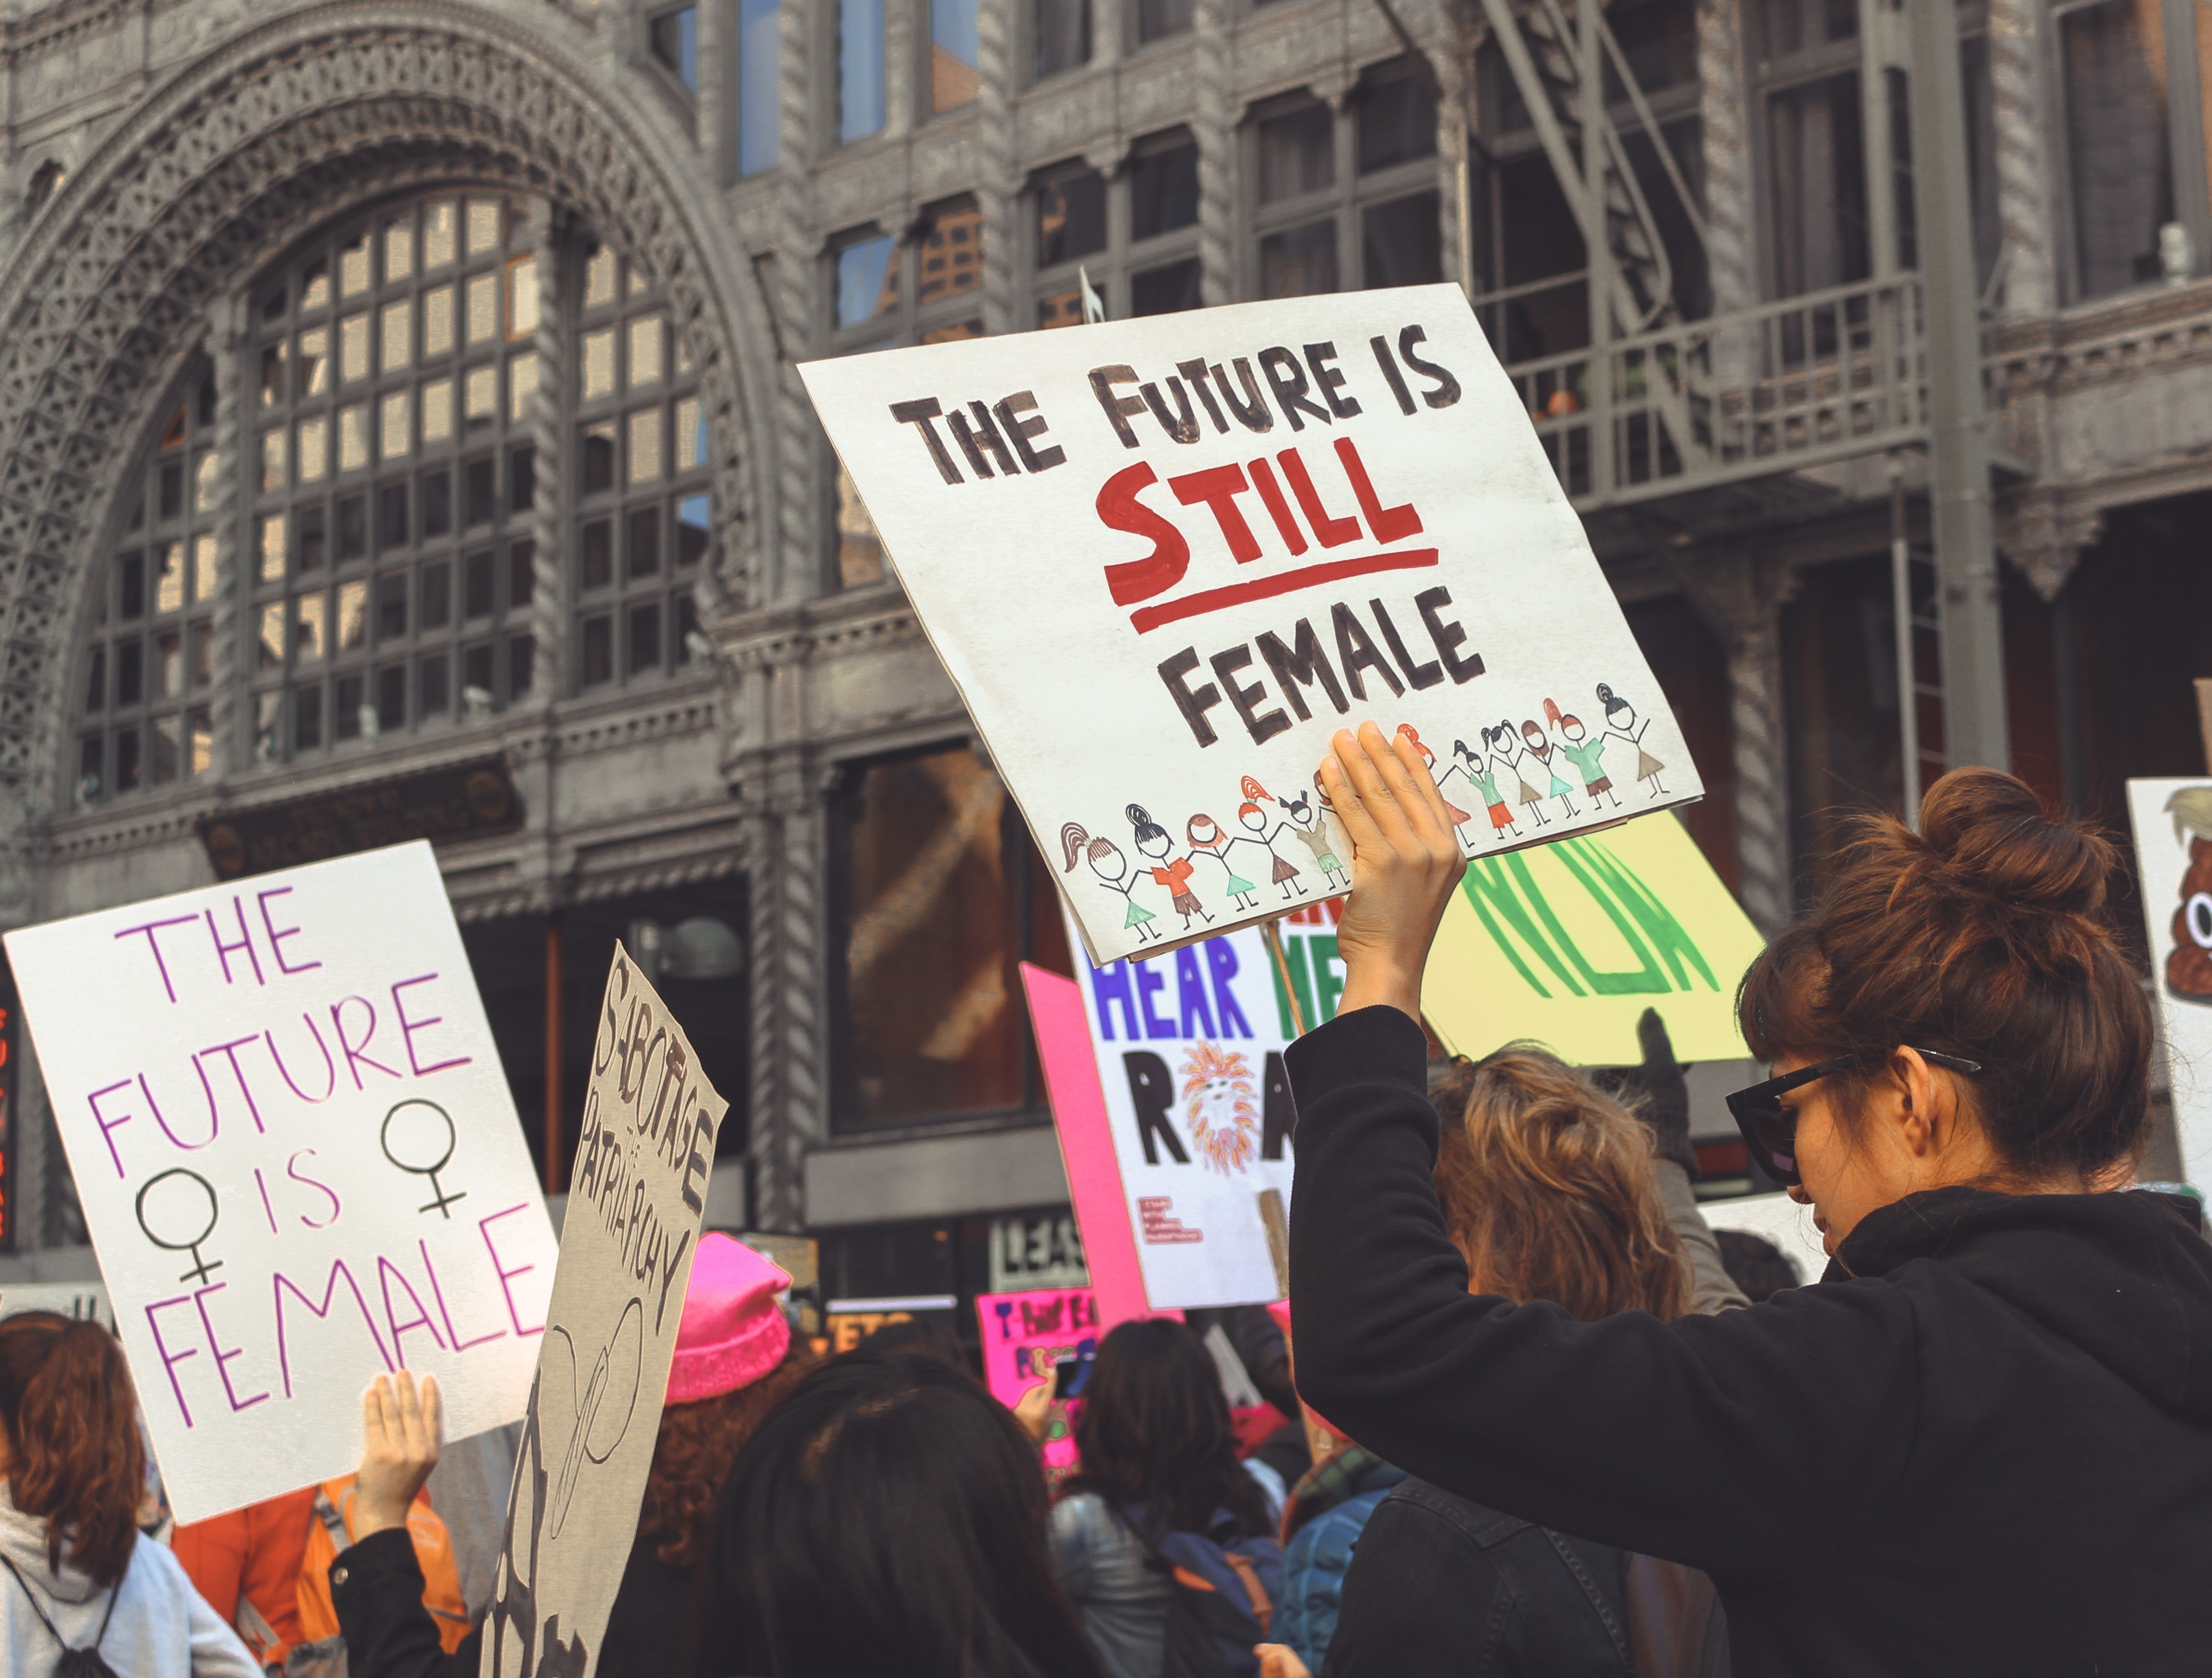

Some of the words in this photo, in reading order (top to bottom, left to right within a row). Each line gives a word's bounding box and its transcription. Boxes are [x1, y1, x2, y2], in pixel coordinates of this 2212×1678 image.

[889, 391, 1067, 485] THE
[1088, 342, 1363, 449] FUTURE
[1370, 325, 1461, 415] IS
[1096, 438, 1423, 606] STILL
[1157, 586, 1485, 748] FEMALE
[114, 886, 322, 1003] THE
[1088, 938, 1253, 1040] HEAR
[88, 973, 472, 1179] FUTURE
[596, 958, 715, 1219] SABOTAGE
[626, 1126, 641, 1169] THE
[254, 1148, 341, 1234] IS
[578, 1086, 691, 1337] PATRIARCHY
[145, 1203, 545, 1428] FEMALE
